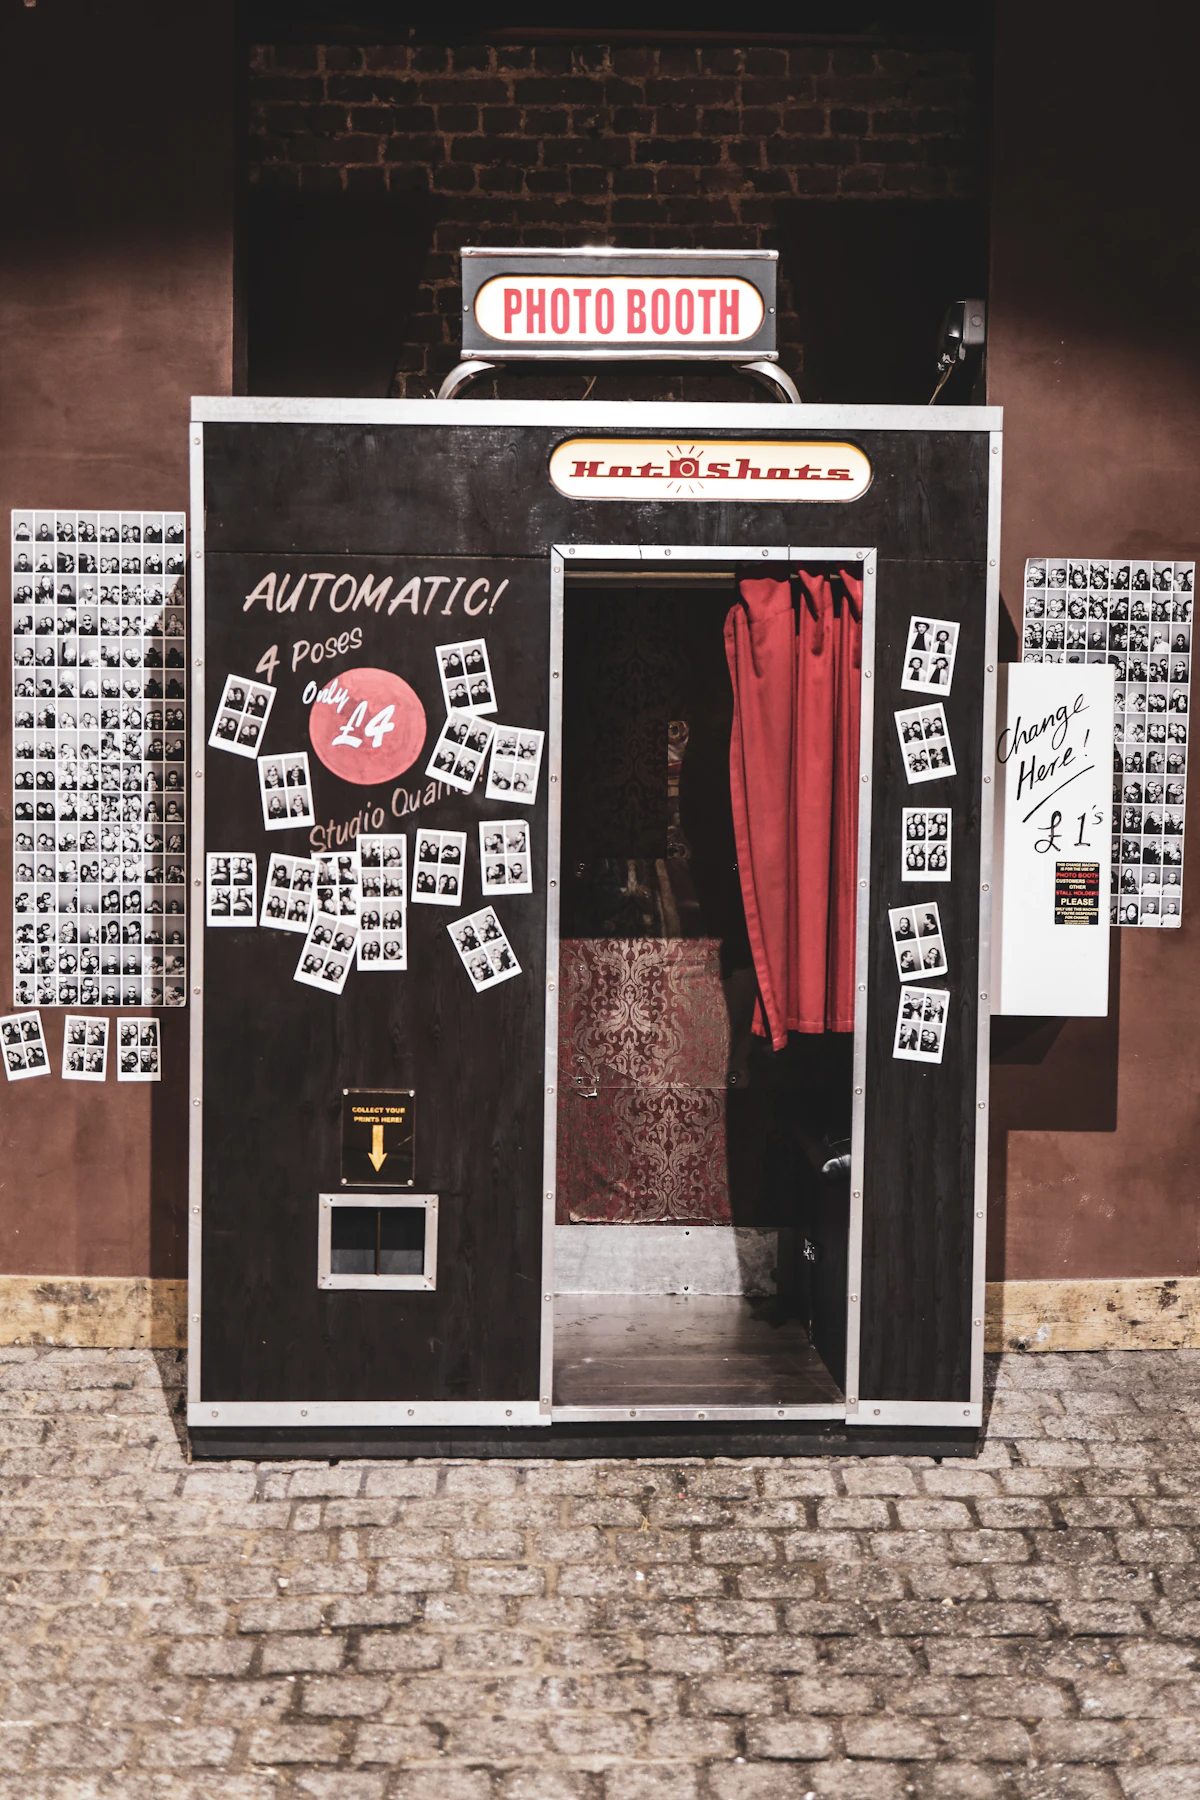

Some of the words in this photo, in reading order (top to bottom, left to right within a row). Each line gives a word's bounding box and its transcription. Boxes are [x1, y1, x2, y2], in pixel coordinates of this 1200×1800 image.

[503, 288, 614, 335] PHOTO
[626, 288, 740, 335] BOOTH
[569, 460, 665, 477] Hot
[705, 459, 855, 480] Shots
[242, 571, 510, 616] AUTOMATIC!
[255, 644, 281, 684] 4
[291, 626, 363, 672] Poses
[302, 678, 350, 713] Only
[331, 701, 396, 749] £4
[996, 693, 1091, 764] Change
[1016, 728, 1091, 801] Here!
[309, 801, 386, 854] Studio
[1060, 898, 1094, 906] PLEASE
